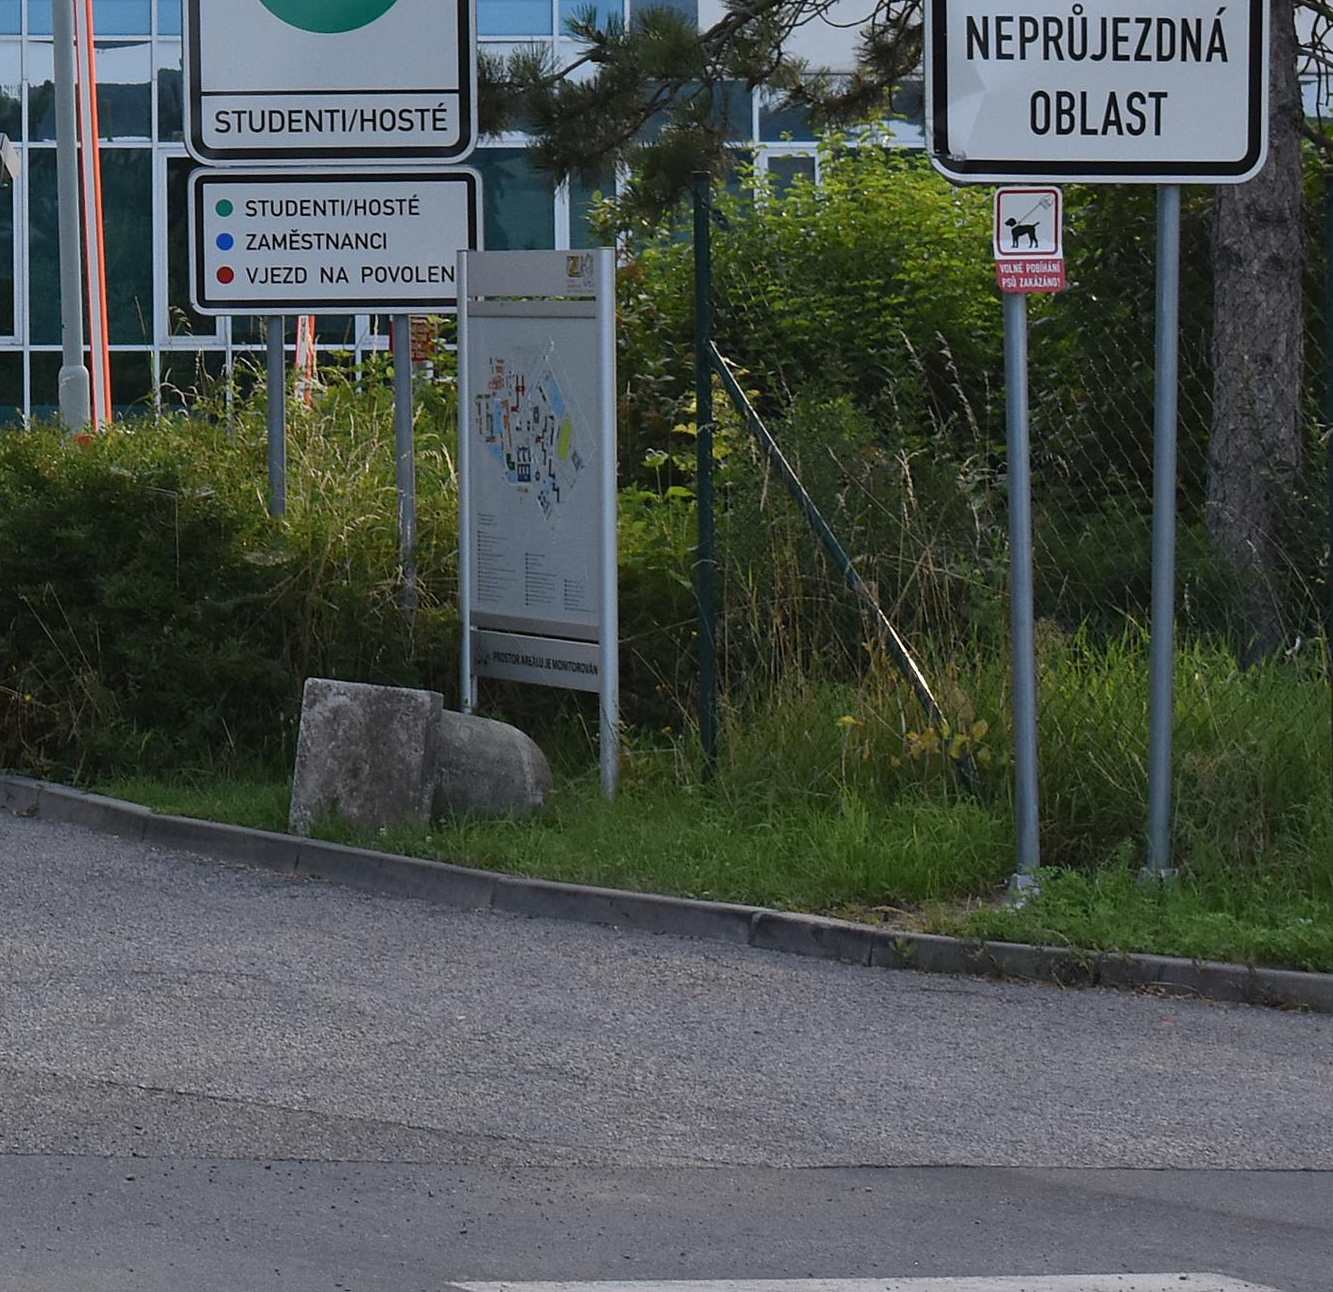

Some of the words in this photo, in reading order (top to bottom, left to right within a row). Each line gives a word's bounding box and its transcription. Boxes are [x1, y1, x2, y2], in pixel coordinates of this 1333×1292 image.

[966, 3, 1229, 63] NEPRŮJEZDNÁ
[214, 102, 448, 134] STUDENTI/HOSTÉ
[1030, 90, 1168, 137] OBLAST
[245, 194, 420, 217] STUDENTI/HOSTÉ
[245, 229, 387, 251] ZAMĚSTNANCI
[245, 266, 308, 285] VJEZD
[320, 266, 350, 284] NA
[361, 265, 455, 284] POVOLEN
[999, 260, 1023, 274] VOLNÉ
